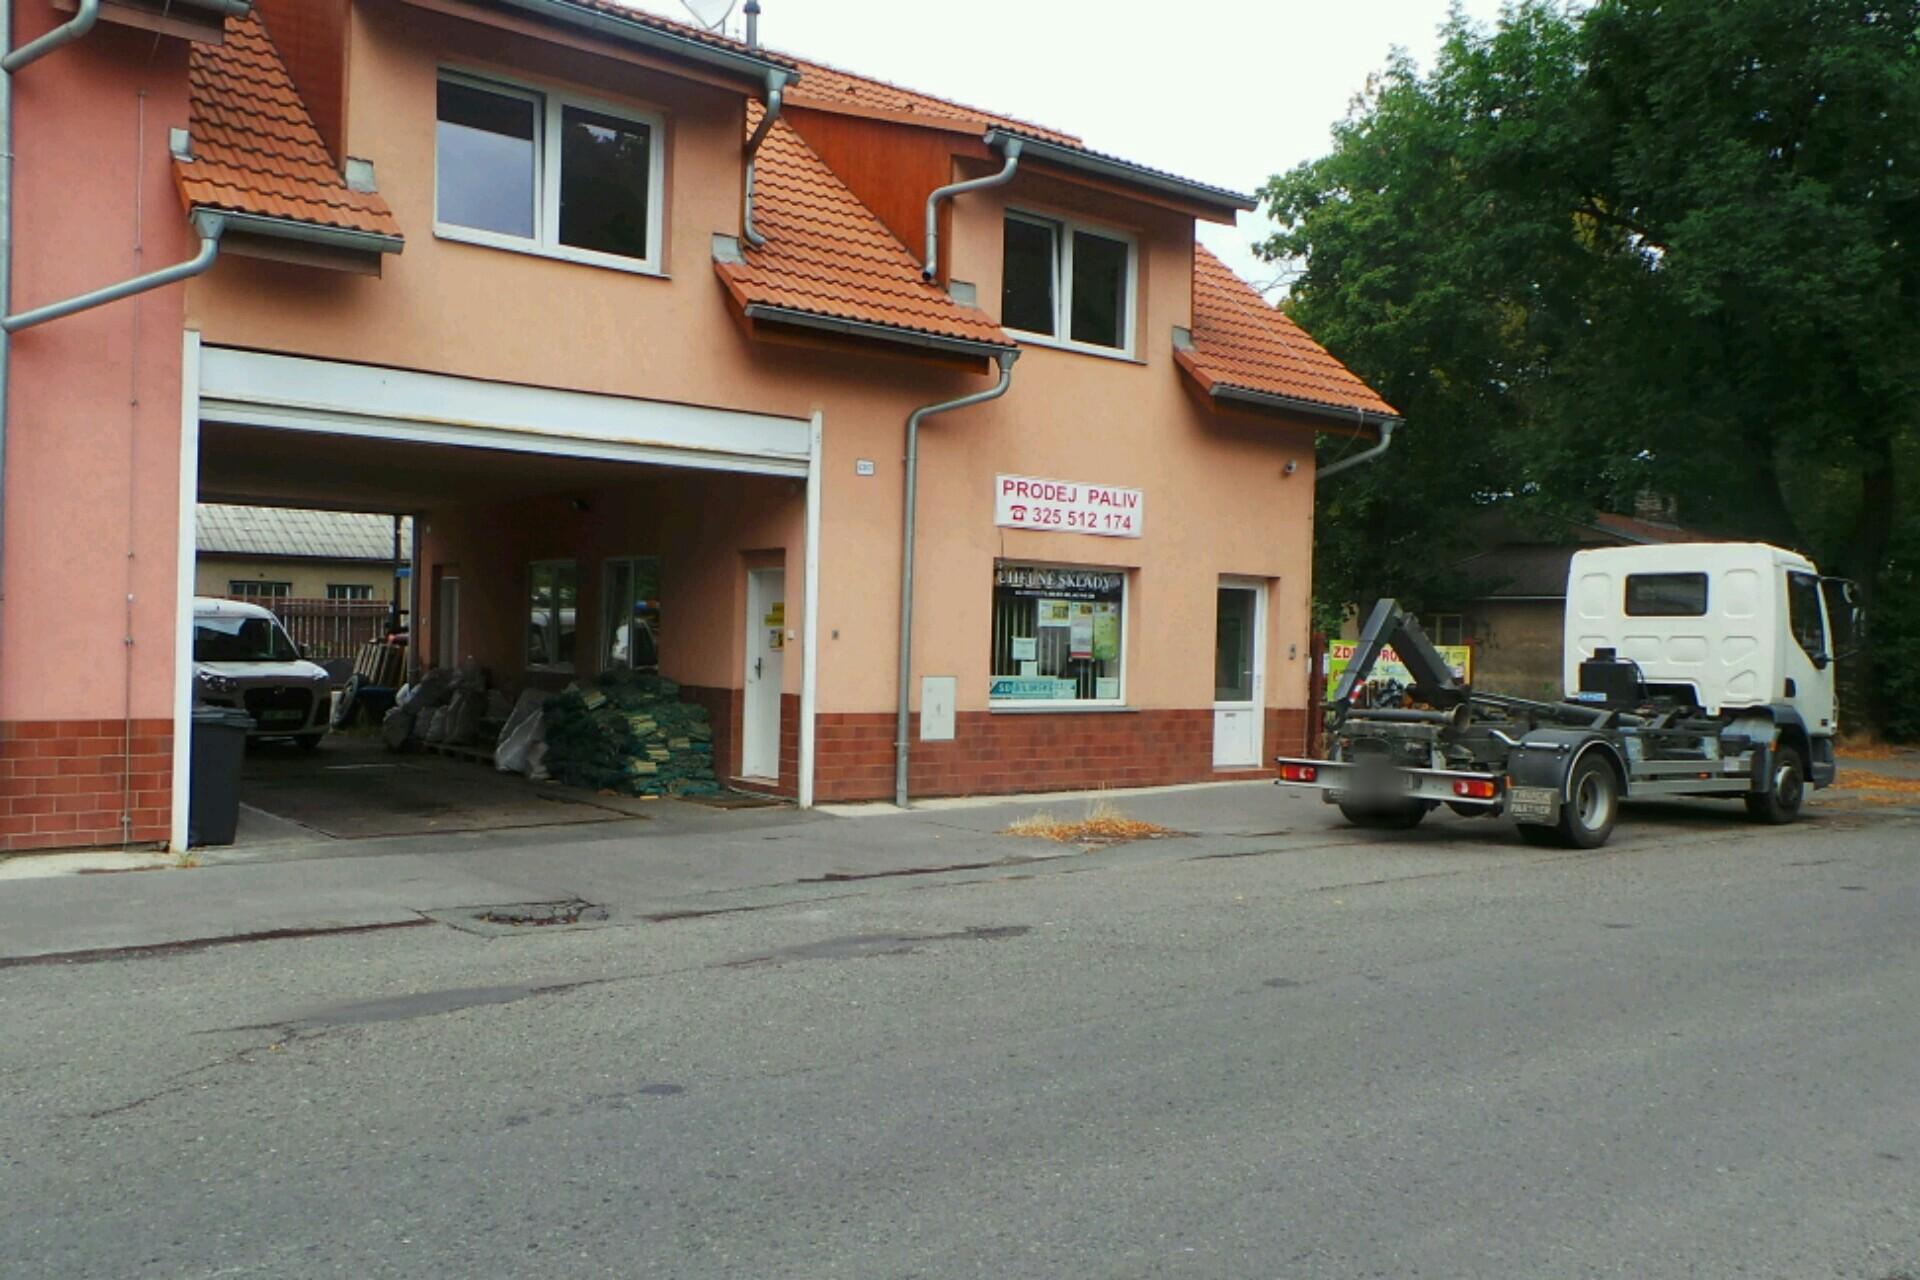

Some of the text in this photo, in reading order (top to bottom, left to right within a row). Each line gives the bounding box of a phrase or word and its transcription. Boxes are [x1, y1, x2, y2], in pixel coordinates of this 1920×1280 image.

[1003, 480, 1137, 508] PRODEJ PALIV
[1032, 507, 1131, 530] 325 512 174
